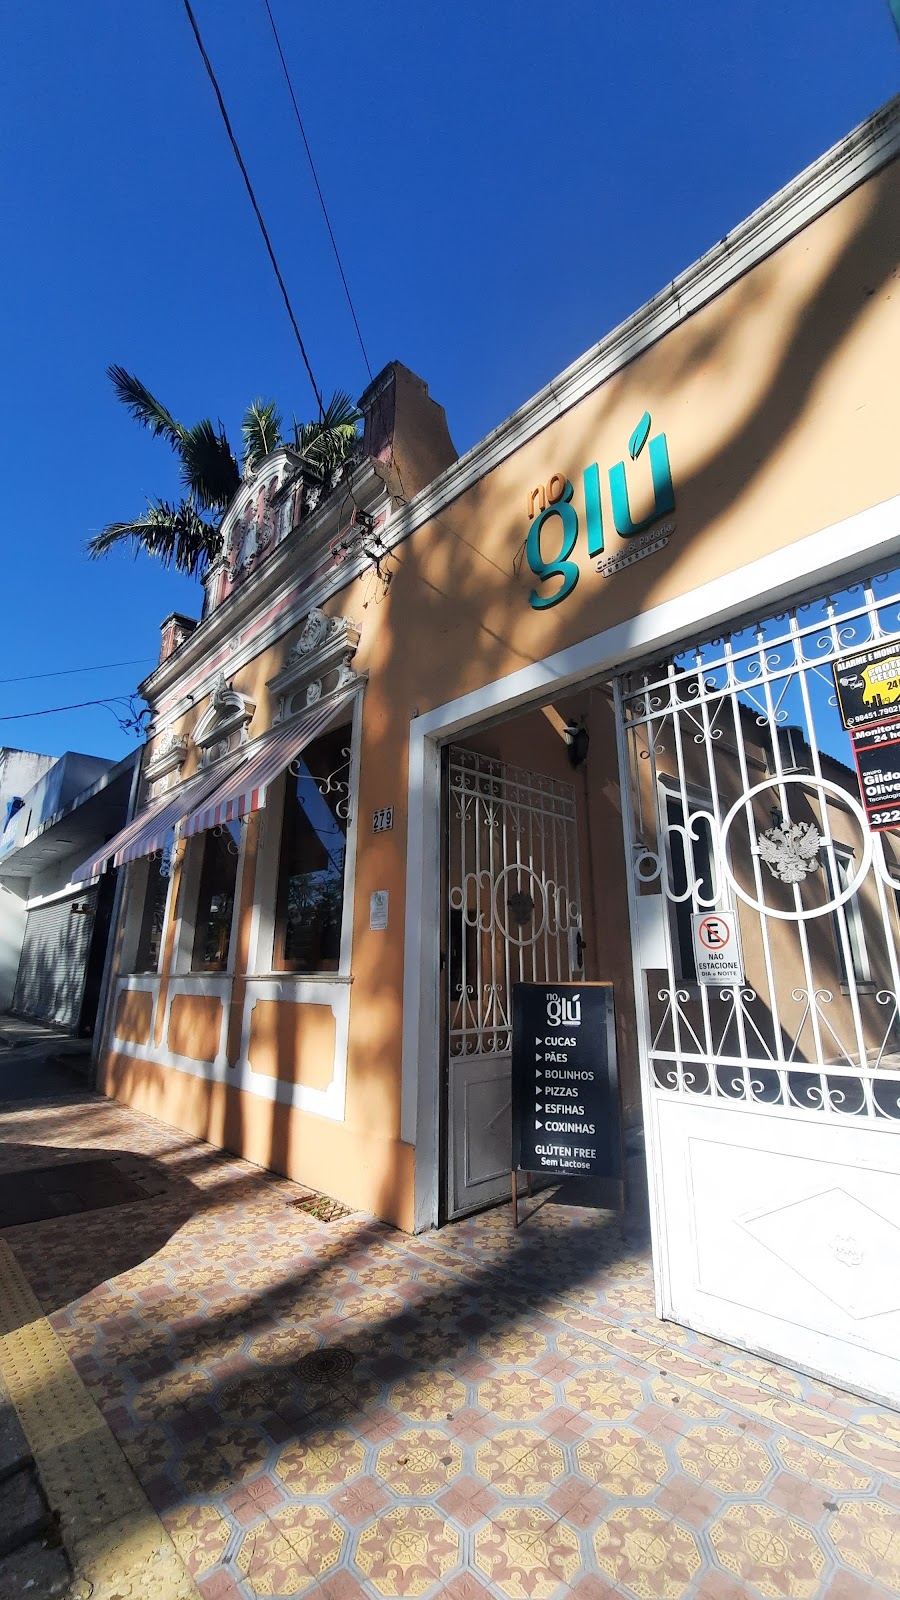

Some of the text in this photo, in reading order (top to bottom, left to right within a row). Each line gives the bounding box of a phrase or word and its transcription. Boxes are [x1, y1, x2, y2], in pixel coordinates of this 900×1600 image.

[527, 472, 567, 520] no
[526, 411, 676, 610] glú
[837, 654, 868, 672] ALARME
[867, 652, 874, 660] E
[886, 679, 898, 691] 24
[873, 732, 888, 743] 24
[863, 771, 900, 786] Gildo
[866, 782, 900, 797] Olive
[373, 811, 392, 829] 279
[708, 951, 724, 961] NÃO
[698, 961, 738, 970] ESTACIONE
[546, 992, 559, 1001] no
[546, 993, 582, 1027] glú
[544, 1036, 577, 1047] CUCAS
[544, 1050, 568, 1063] PÃES
[544, 1069, 595, 1082] BOLINHOS
[544, 1086, 579, 1098] PIZZAS
[544, 1103, 585, 1116] ESFIHAS
[544, 1121, 596, 1135] COXINHAS
[534, 1143, 597, 1159] GLÚTEN FREE
[540, 1156, 591, 1170] Sem Lactose
